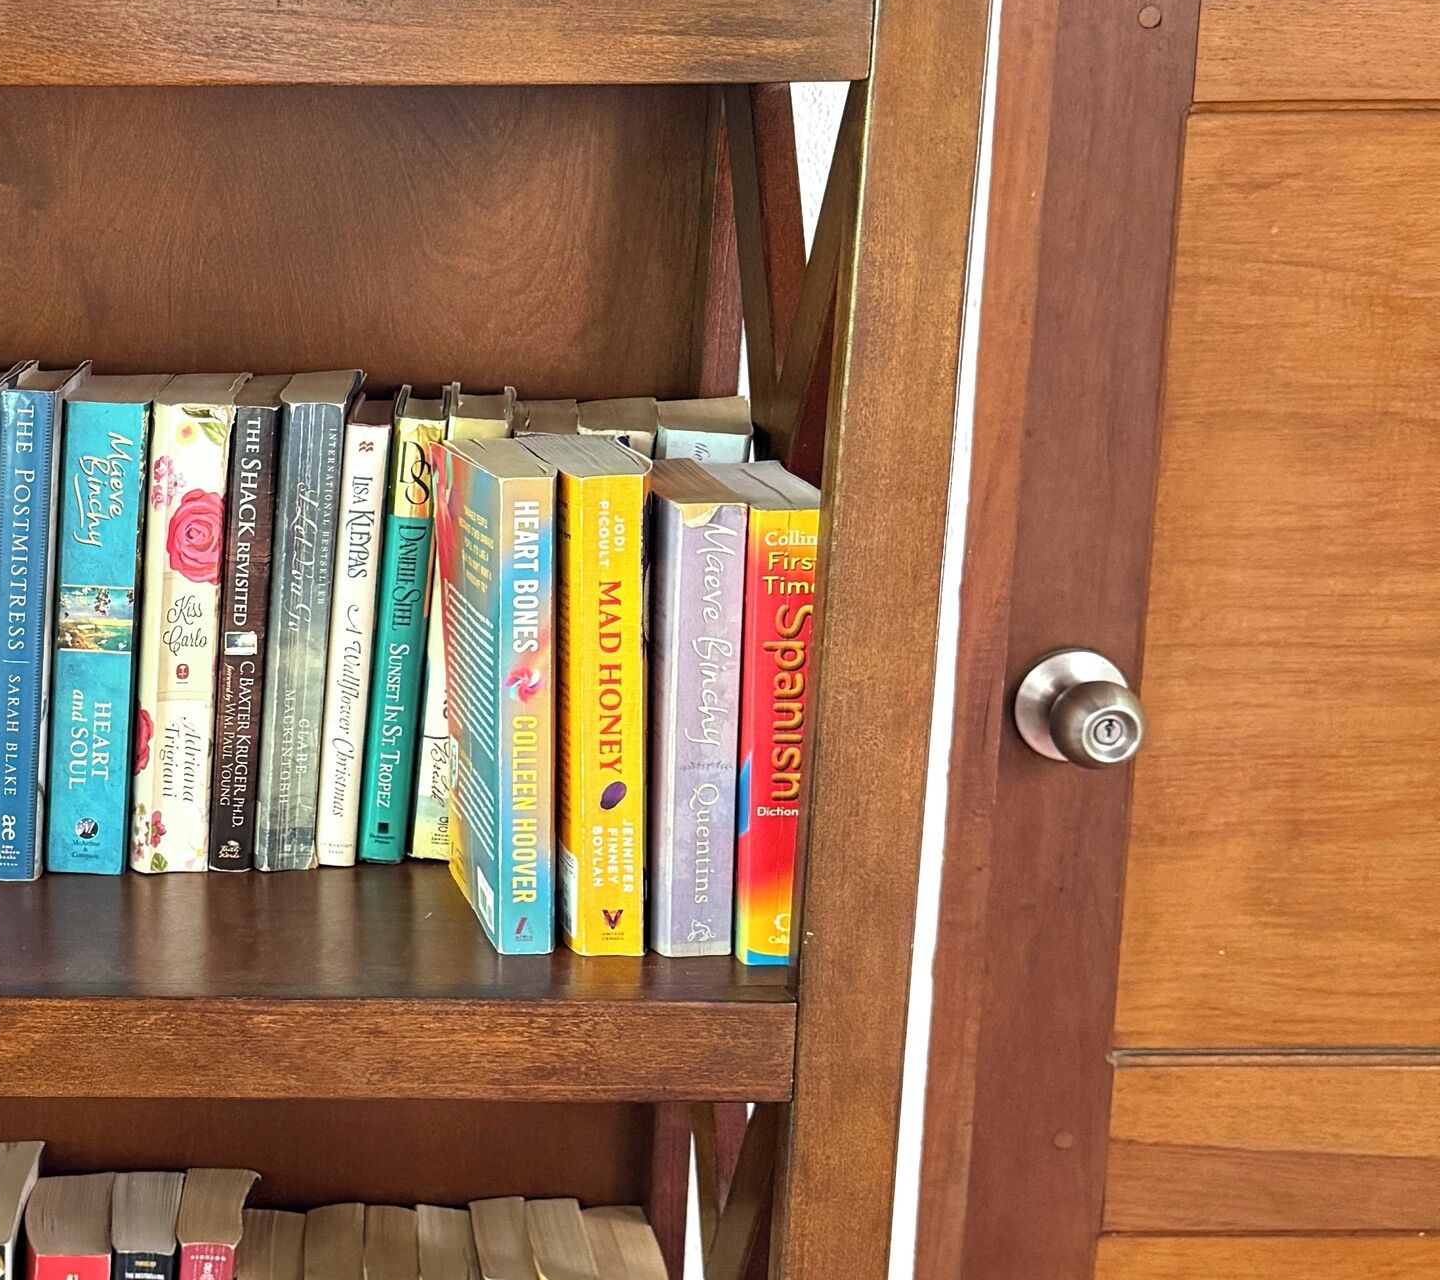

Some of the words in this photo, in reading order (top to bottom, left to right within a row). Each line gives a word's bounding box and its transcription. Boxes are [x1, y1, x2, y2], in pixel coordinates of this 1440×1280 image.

[15, 402, 36, 453] THE
[246, 417, 261, 452] THE
[73, 455, 109, 547] Binchy
[108, 431, 134, 520] Maeve
[238, 456, 261, 537] SHACK
[7, 469, 35, 650] POSTMISTRESS
[512, 501, 540, 572] HEART
[233, 541, 250, 627] REVISITED
[511, 578, 540, 654] BONES
[598, 581, 622, 652] MAD
[7, 675, 22, 732] SARAH
[71, 690, 84, 721] and
[91, 702, 112, 780] HEART
[598, 664, 623, 775] HONEY
[4, 742, 18, 796] BLAKE
[68, 727, 89, 790] SOUL
[511, 716, 537, 811] COLLEEN
[511, 818, 536, 904] HOOVER
[691, 782, 719, 905] Quentins
